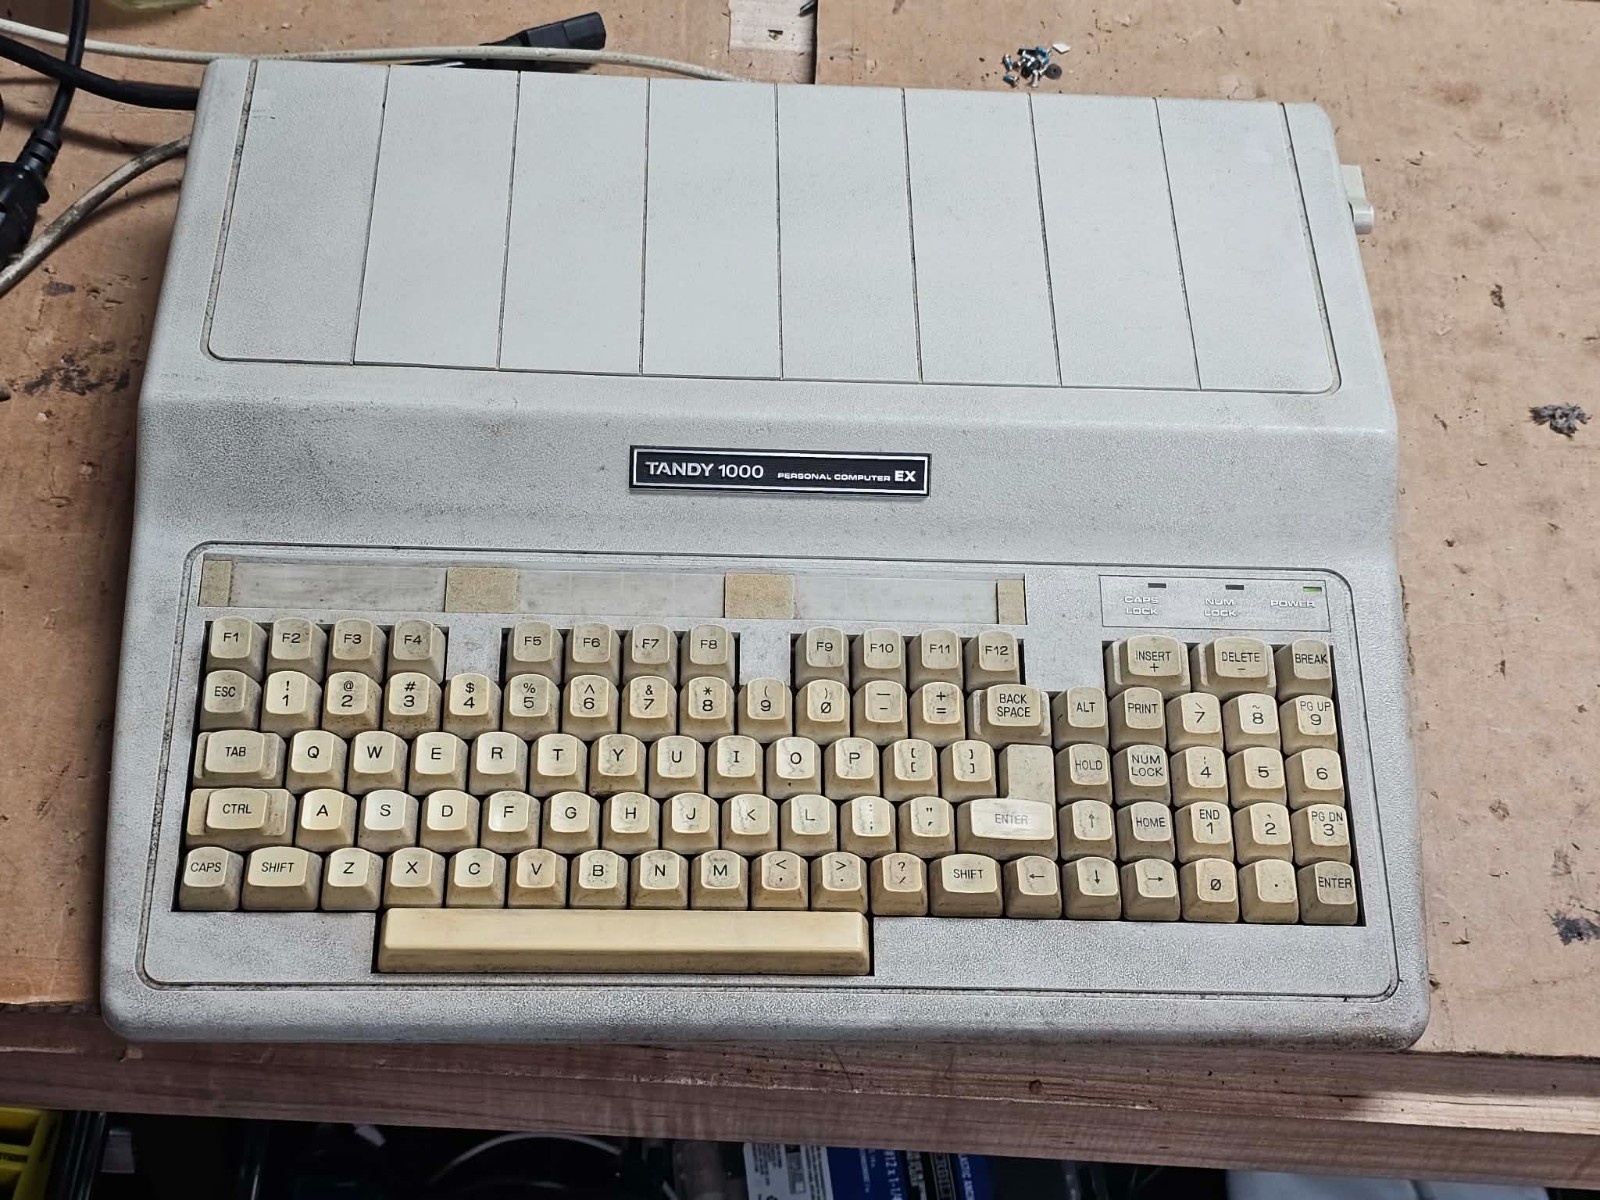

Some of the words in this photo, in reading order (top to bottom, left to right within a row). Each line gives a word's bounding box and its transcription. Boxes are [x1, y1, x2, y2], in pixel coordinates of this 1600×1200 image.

[645, 461, 714, 477] TANDY
[718, 463, 764, 479] 1000
[777, 472, 832, 481] PERSONAL
[834, 474, 891, 482] COMPUTER
[894, 470, 916, 482] EX
[1124, 596, 1159, 604] CAPS
[1205, 598, 1234, 606] NUM
[1126, 607, 1158, 615] LOCK
[1204, 609, 1237, 617] LOCK
[223, 632, 239, 643] F1
[282, 633, 300, 643] F2
[344, 634, 362, 644] F3
[404, 634, 422, 645] F4
[524, 636, 542, 646] F5
[583, 638, 600, 648] F6
[642, 639, 660, 648] F7
[700, 640, 717, 650] F8
[816, 642, 833, 652] F9
[870, 643, 894, 653] F10
[930, 644, 951, 654] F11
[985, 646, 1008, 656] F12
[1135, 651, 1171, 662] INSERT
[1221, 652, 1261, 663] DELETE
[1295, 653, 1328, 664] BREAK
[1150, 663, 1160, 672] +
[214, 686, 236, 697] ESC
[286, 681, 290, 691] !
[343, 681, 354, 691] @
[405, 682, 416, 692] #
[465, 682, 475, 693] $
[523, 683, 536, 693] %
[645, 685, 654, 695] &
[282, 695, 289, 706] 1
[341, 695, 353, 707] 2
[403, 696, 415, 707] 3
[936, 691, 946, 701] +
[999, 694, 1028, 704] BACK
[463, 697, 476, 708] 4
[524, 697, 534, 709] 5
[584, 698, 595, 710] 6
[643, 699, 655, 710] 7
[702, 700, 713, 712] 8
[760, 700, 771, 712] 9
[1076, 702, 1096, 712] ALT
[1300, 701, 1314, 711] PG
[1317, 701, 1331, 712] UP
[997, 707, 1031, 717] SPACE
[1128, 703, 1158, 714] PRINT
[1194, 711, 1206, 723] 7
[1253, 712, 1264, 724] 8
[1311, 714, 1322, 725] 9
[225, 746, 246, 757] TAB
[307, 746, 320, 759] Q
[367, 746, 383, 758] W
[431, 747, 442, 760] E
[491, 747, 503, 759] R
[552, 749, 564, 761] T
[612, 749, 625, 761] Y
[671, 750, 682, 763] U
[734, 750, 740, 763] I
[790, 752, 802, 765] O
[850, 752, 860, 764] P
[1131, 755, 1161, 764] NUM
[1075, 760, 1103, 771] HOLD
[1131, 767, 1163, 777] LOCK
[1200, 767, 1212, 778] 4
[1258, 766, 1269, 778] 5
[1317, 768, 1329, 780] 6
[223, 804, 252, 815] CTRL
[316, 804, 329, 817] A
[380, 804, 391, 817] S
[442, 805, 454, 817] D
[503, 805, 514, 818] F
[565, 807, 576, 819] G
[625, 807, 637, 819] H
[686, 808, 696, 820] J
[746, 808, 756, 821] K
[805, 809, 816, 821] L
[1200, 809, 1220, 820] END
[995, 813, 1029, 825] ENTER
[1311, 811, 1325, 821] PG
[1329, 811, 1343, 822] DN
[1136, 817, 1166, 828] HOME
[1207, 823, 1213, 834] 1
[1265, 823, 1277, 835] 2
[1323, 824, 1335, 836] 3
[190, 861, 221, 873] CAPS
[261, 862, 294, 873] SHIFT
[343, 862, 354, 874] Z
[406, 861, 418, 874] X
[468, 862, 481, 875] C
[531, 862, 542, 876] V
[713, 864, 728, 876] M
[776, 859, 787, 870] <
[835, 860, 847, 871] >
[898, 861, 905, 872] ?
[593, 864, 604, 877] B
[655, 864, 666, 877] N
[953, 868, 984, 879] SHIFT
[1318, 876, 1352, 889] ENTER
